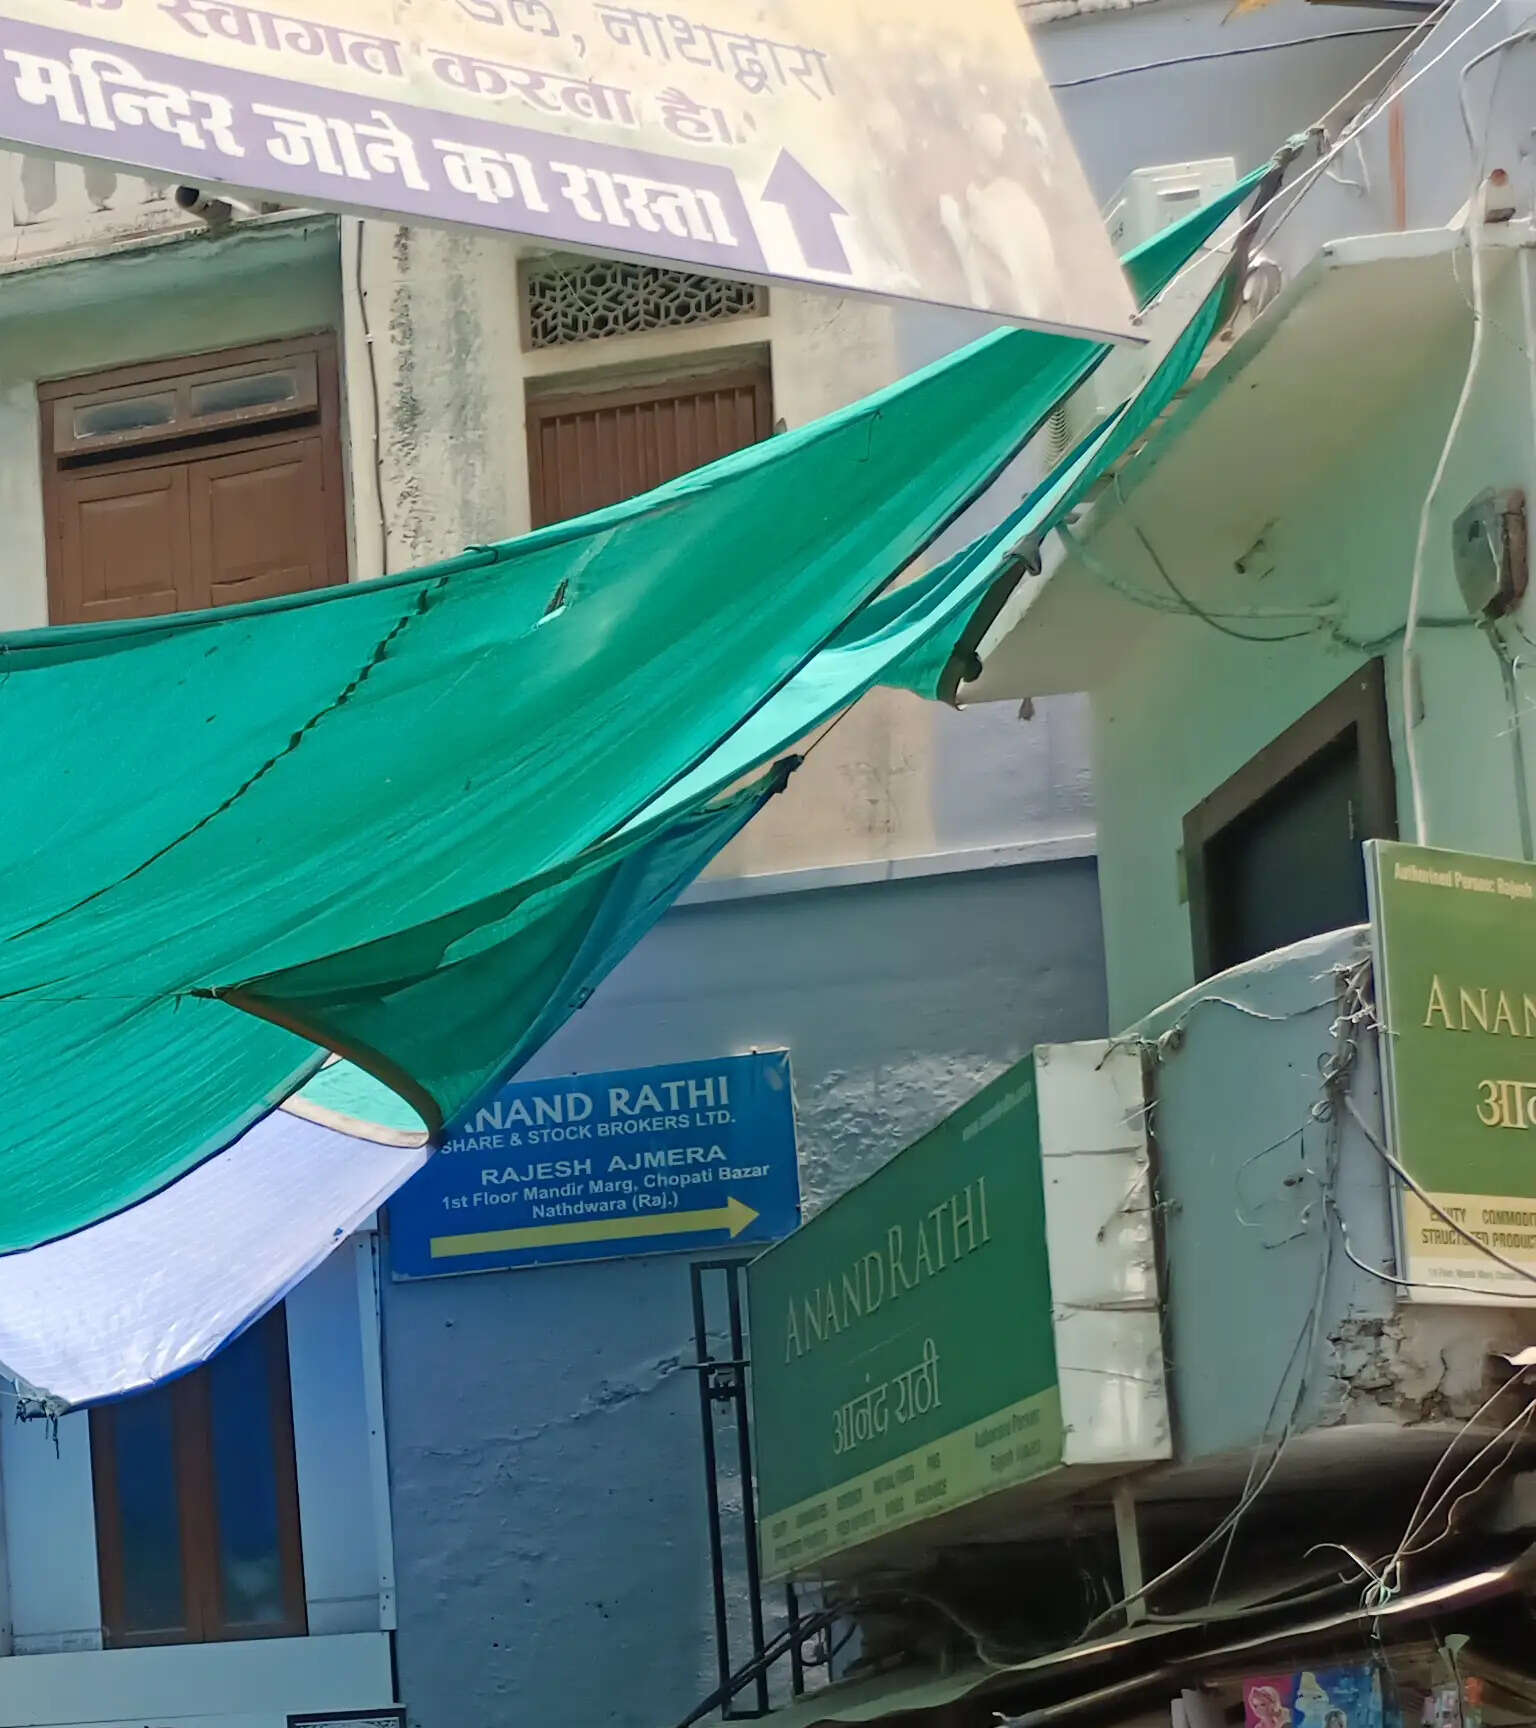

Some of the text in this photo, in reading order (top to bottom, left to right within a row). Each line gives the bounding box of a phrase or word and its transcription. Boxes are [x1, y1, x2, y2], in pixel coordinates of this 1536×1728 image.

[427, 47, 636, 126] करता
[5, 47, 245, 157] मन्दिर
[252, 99, 429, 192] जाने
[427, 137, 548, 212] का
[547, 159, 739, 247] रास्ता
[464, 1076, 731, 1134] NAND RATHI
[441, 1109, 736, 1155] SHARE & STOCK BROKERS LTD.
[442, 1163, 770, 1211] 1st Floor Mandir Marg, Chopati Bazar
[481, 1144, 727, 1186] RAJESH AJMERA
[531, 1197, 628, 1220] Nathdwara
